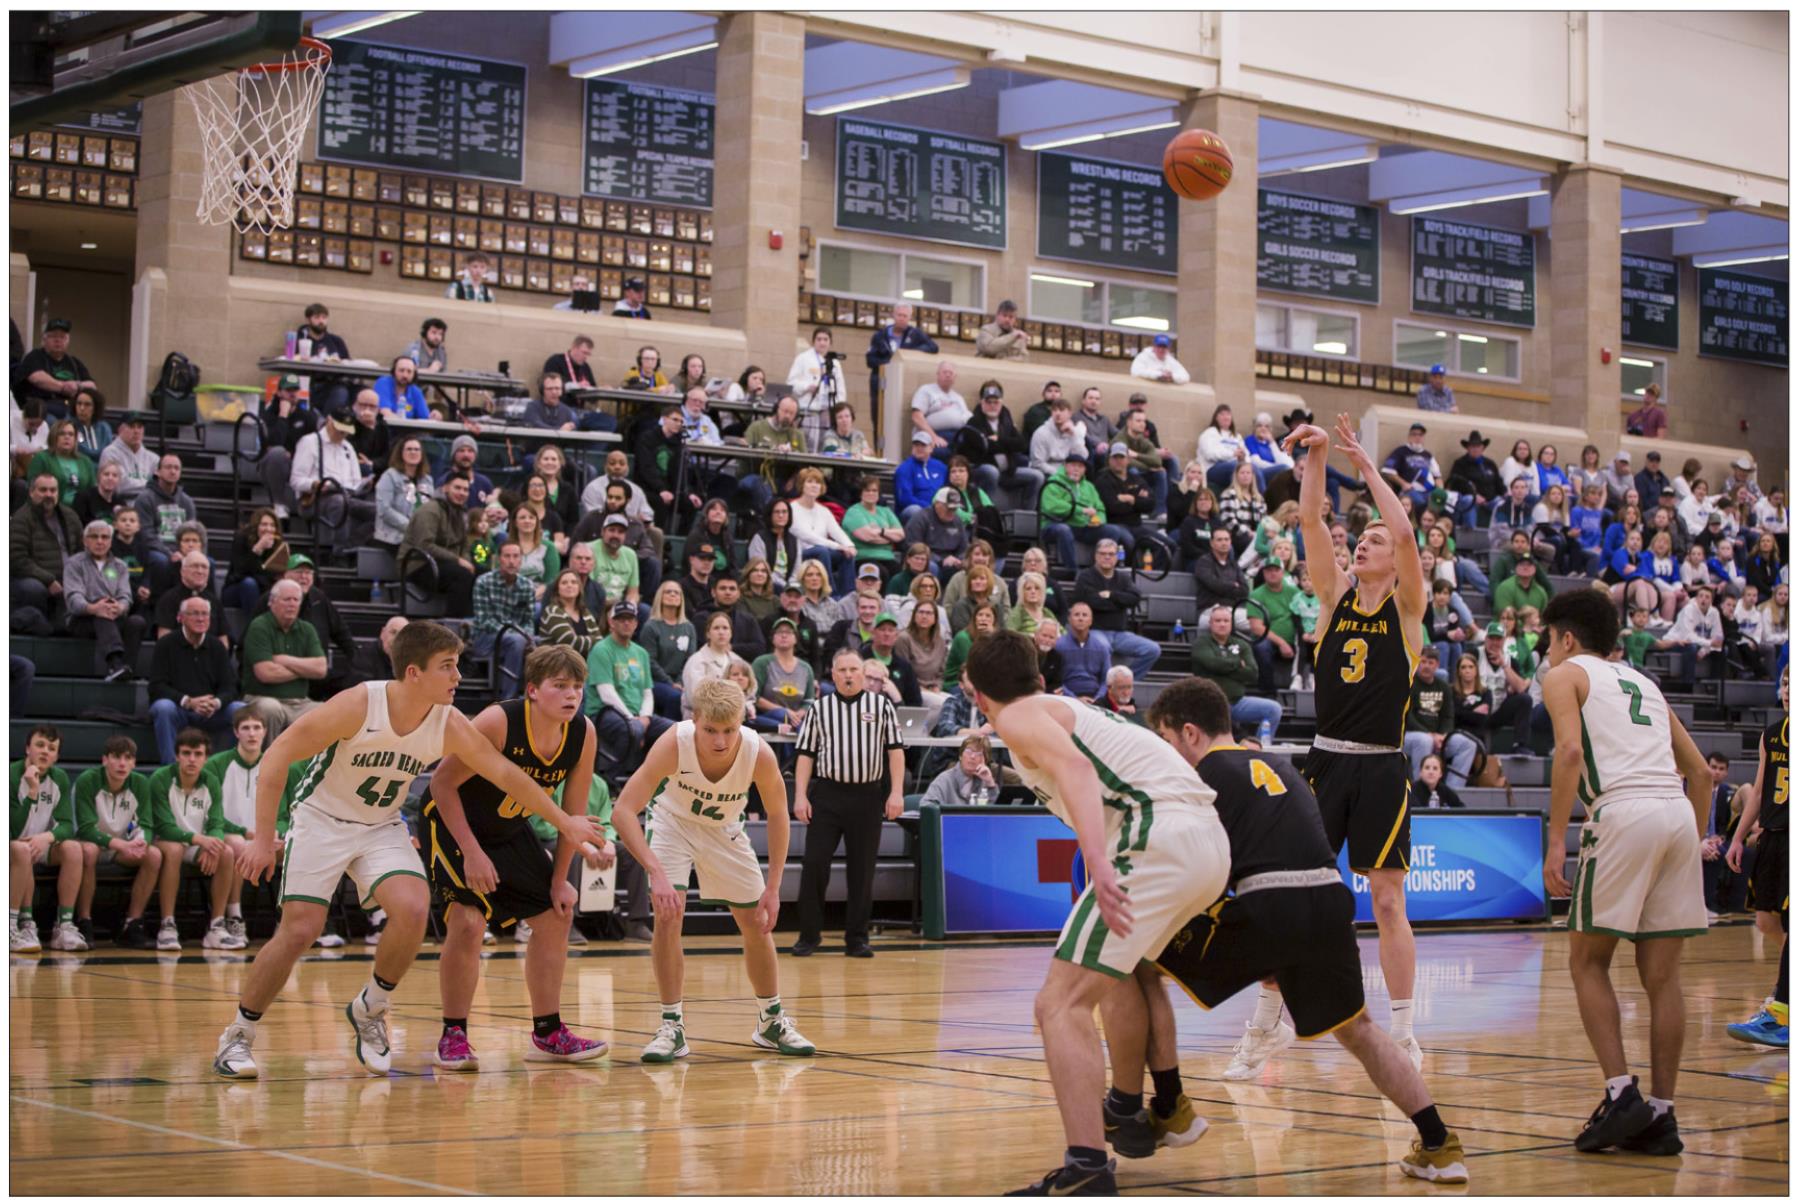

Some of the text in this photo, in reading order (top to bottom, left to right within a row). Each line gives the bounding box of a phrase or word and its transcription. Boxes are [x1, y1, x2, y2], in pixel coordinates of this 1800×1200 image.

[844, 123, 918, 144] BASEBALL RECORDS
[930, 136, 1000, 157] SOFTBALL RECORDS
[1070, 162, 1162, 187] WRESTLING RECORDS
[1288, 197, 1320, 212] SOCCER
[1320, 202, 1356, 218] RECORDS
[1490, 230, 1522, 246] RECORDS
[1288, 245, 1320, 260] SOCCER
[1321, 250, 1356, 266] RECORDS
[1492, 276, 1524, 292] RECORDS
[1732, 280, 1746, 292] GOLF
[1747, 282, 1774, 298] RECORDS
[1732, 318, 1748, 330] GOLF
[1748, 320, 1776, 335] RECORDS
[1341, 638, 1368, 683] 3
[1618, 679, 1652, 726] 2
[351, 752, 395, 768] SACRED
[1249, 759, 1288, 796] 4
[1774, 766, 1789, 804] 5
[356, 776, 406, 808] 45
[678, 780, 713, 800] SACRED
